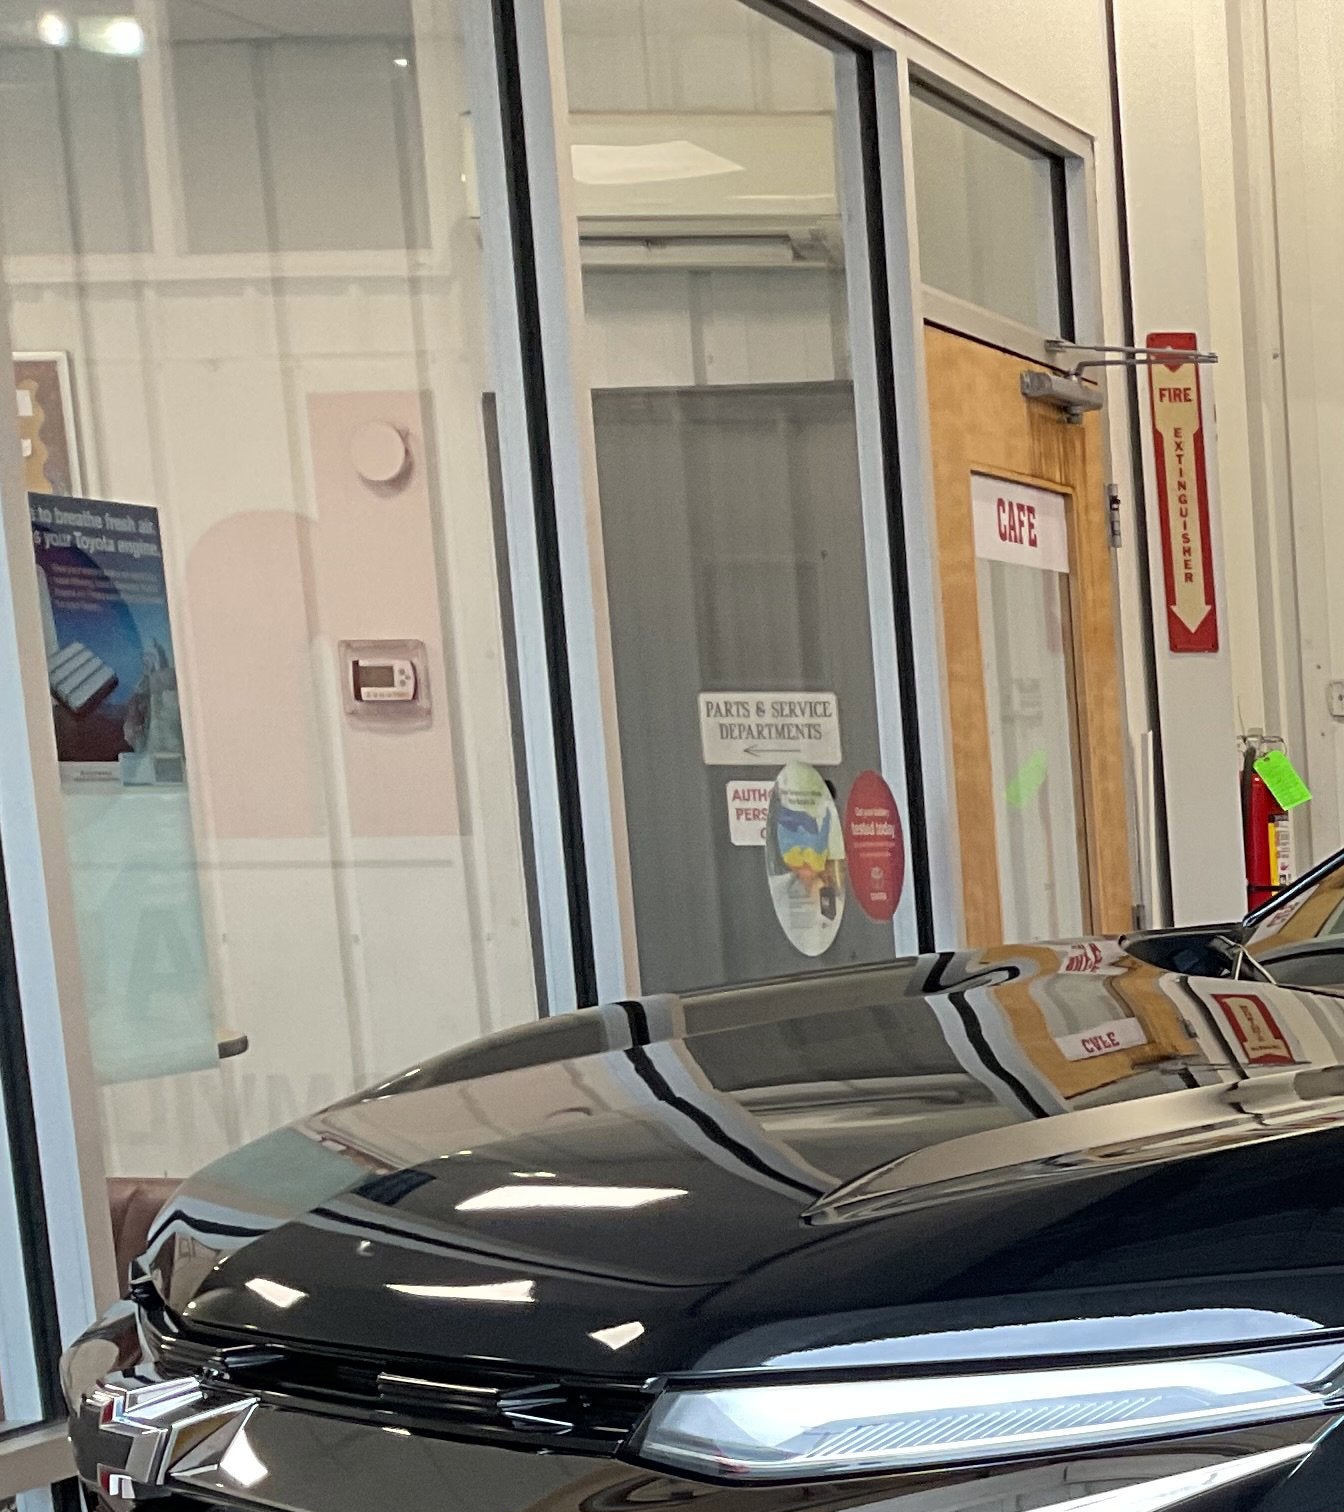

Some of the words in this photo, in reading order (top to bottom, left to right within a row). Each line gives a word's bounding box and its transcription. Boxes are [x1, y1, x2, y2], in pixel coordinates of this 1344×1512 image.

[1158, 387, 1193, 404] FIRE
[1172, 427, 1195, 584] EXTINGUISHER
[996, 497, 1039, 549] CAFE
[43, 532, 72, 549] your
[73, 531, 116, 554] Toyota
[705, 701, 750, 718] PARTS
[755, 701, 766, 717] &
[771, 701, 833, 718] SERVICE
[719, 723, 823, 741] DEPARTMENTS
